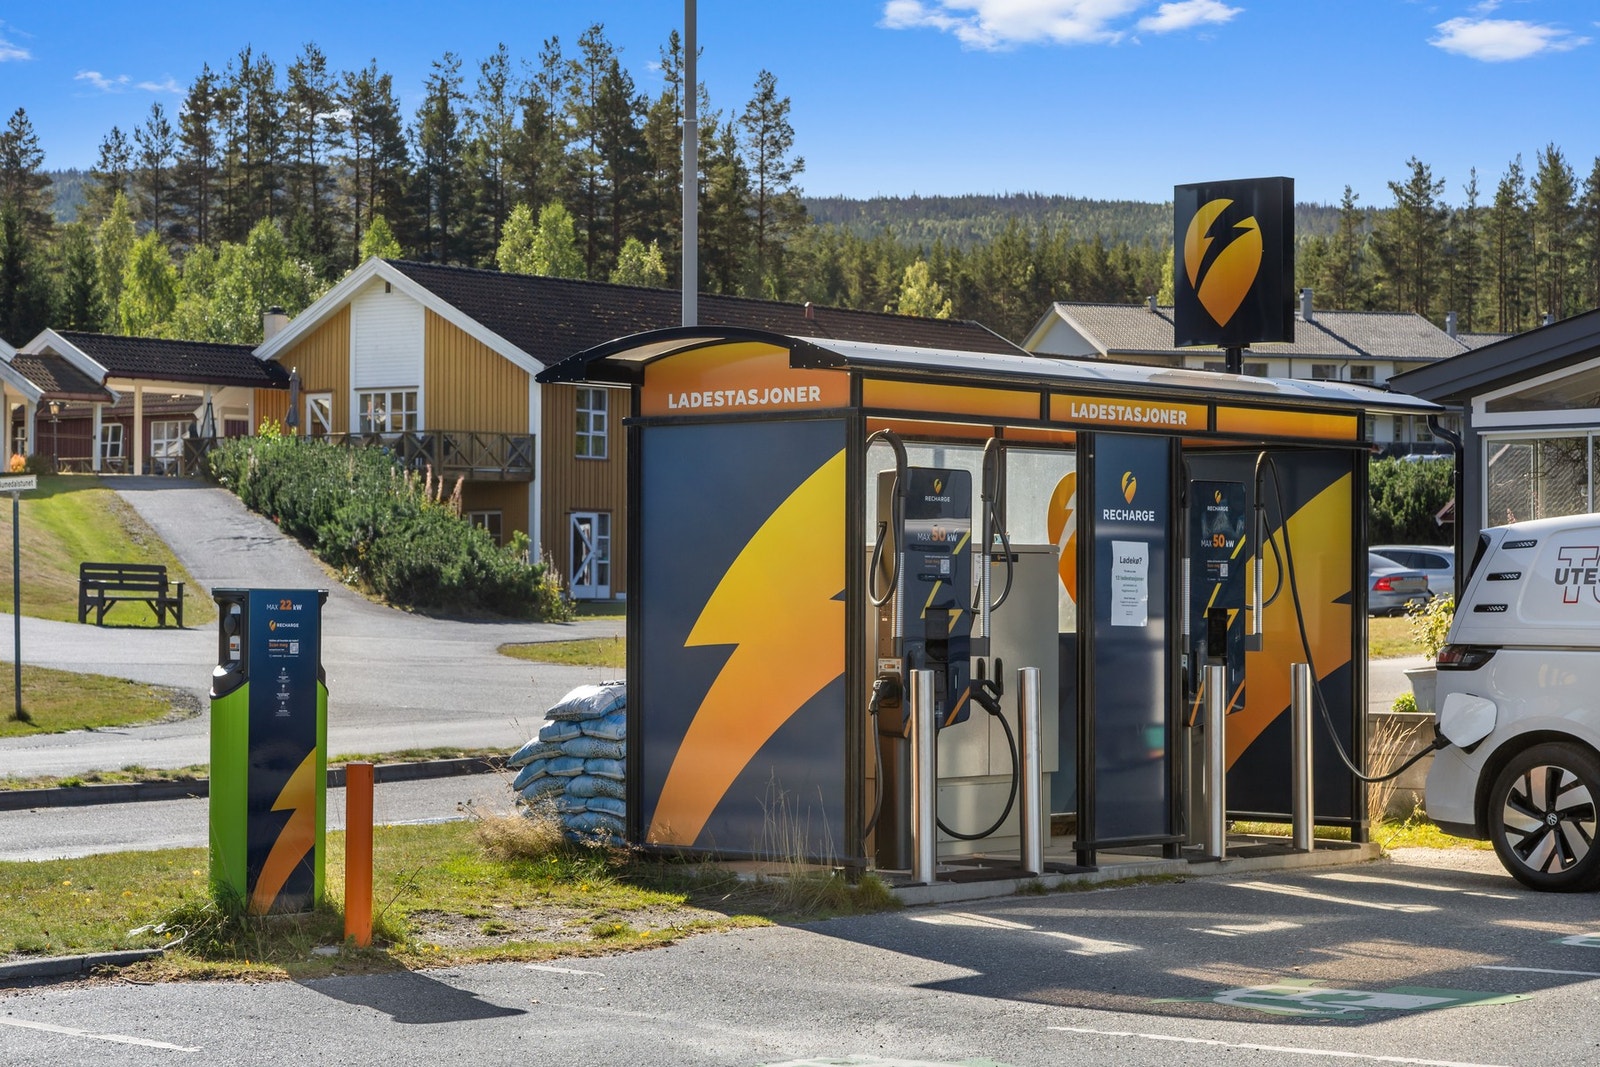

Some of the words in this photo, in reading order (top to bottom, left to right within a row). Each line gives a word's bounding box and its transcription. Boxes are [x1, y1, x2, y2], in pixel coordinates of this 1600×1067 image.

[668, 385, 821, 409] LADESTASJONER
[1071, 402, 1187, 425] LADESTASJONER
[924, 495, 951, 503] RECHARGE
[1103, 508, 1155, 521] RECHARGE
[917, 533, 931, 541] MAX
[931, 526, 947, 542] 50
[947, 533, 957, 542] kW
[1201, 540, 1212, 548] MAX
[1213, 533, 1225, 548] 50
[1225, 540, 1235, 548] kW
[1120, 555, 1143, 565] Ladekø?
[1554, 567, 1600, 585] UTE
[279, 599, 293, 611] 22
